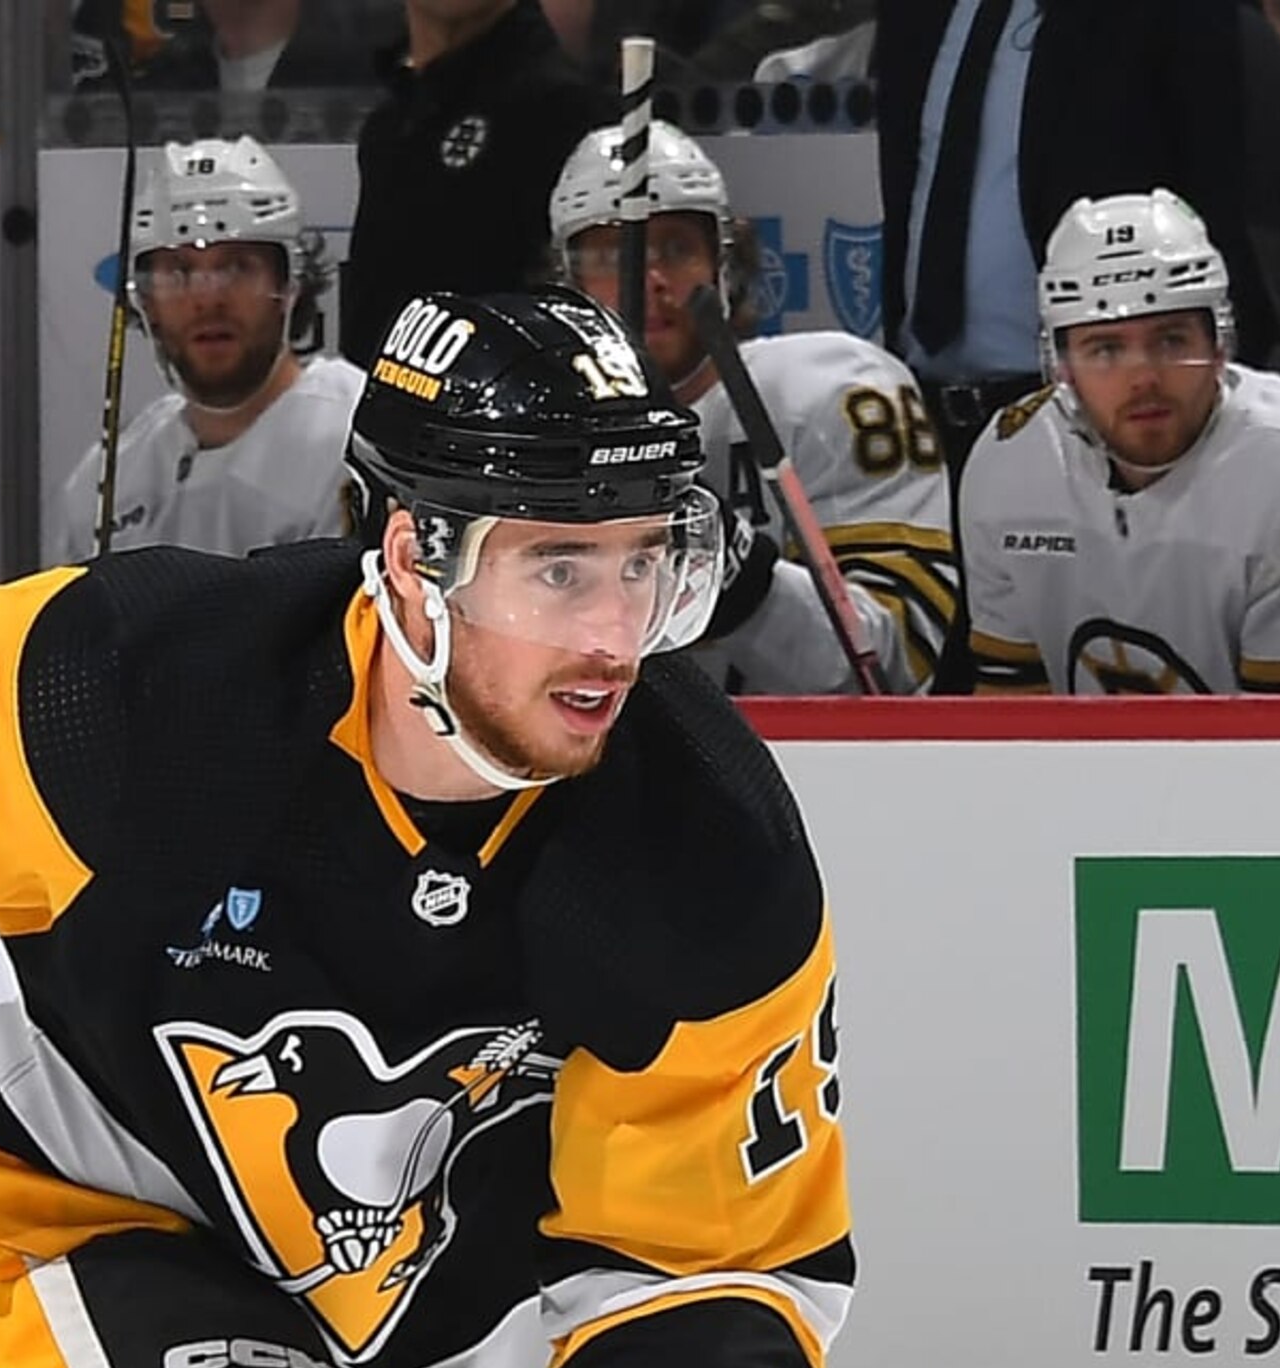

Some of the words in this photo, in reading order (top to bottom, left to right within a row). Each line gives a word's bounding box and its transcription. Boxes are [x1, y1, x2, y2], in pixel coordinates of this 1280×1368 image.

[1106, 225, 1135, 245] 19
[1092, 268, 1156, 287] CCM
[372, 356, 443, 401] PENGUIN
[589, 441, 677, 465] BAUER
[1088, 1259, 1222, 1354] The
